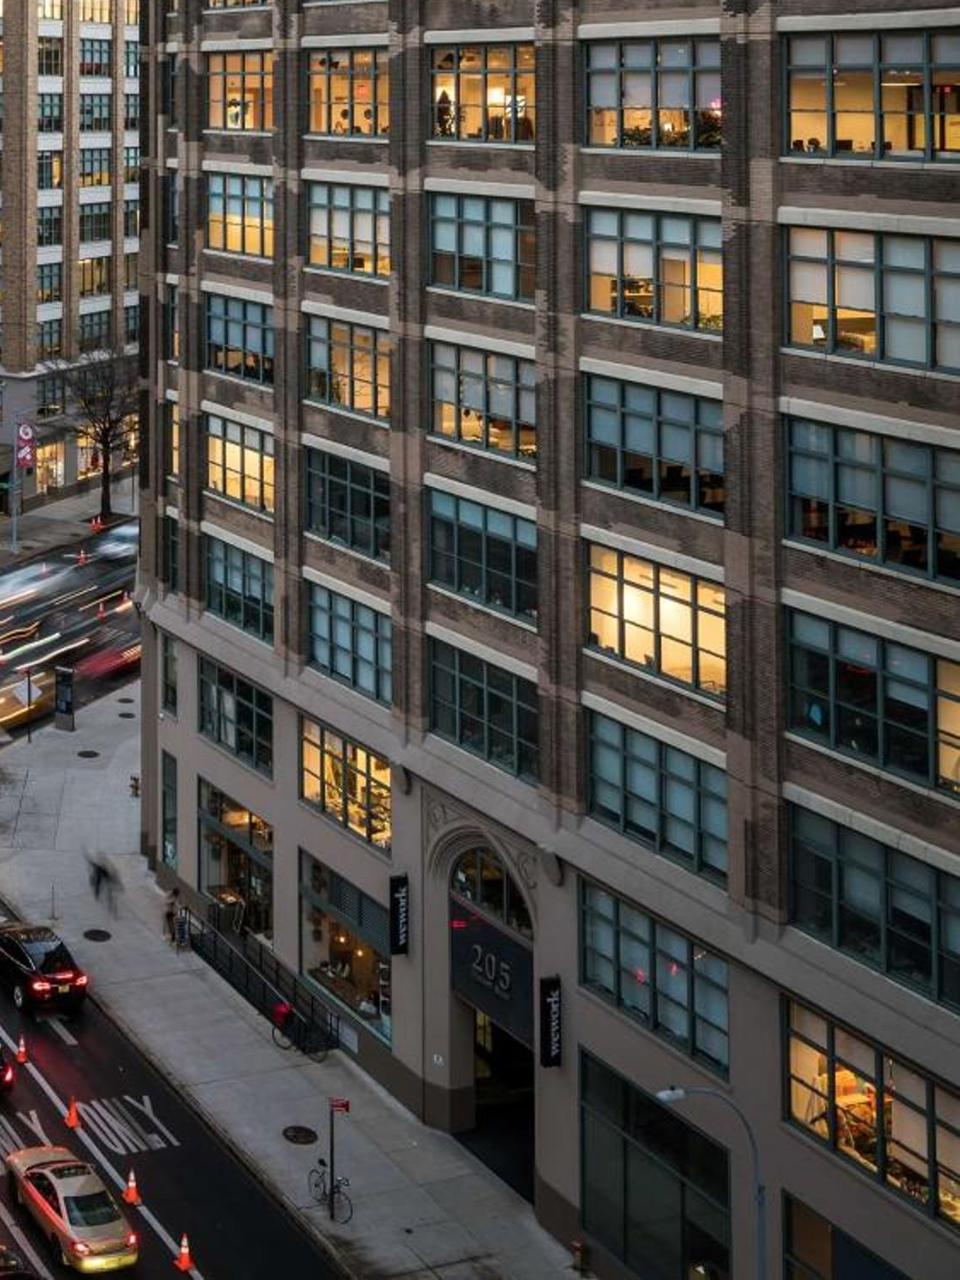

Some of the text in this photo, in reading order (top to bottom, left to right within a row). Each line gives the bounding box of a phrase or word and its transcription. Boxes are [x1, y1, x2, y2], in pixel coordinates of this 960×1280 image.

[395, 887, 407, 946] wework
[472, 944, 510, 990] 205
[546, 989, 560, 1057] wework
[75, 1095, 181, 1156] ONLY
